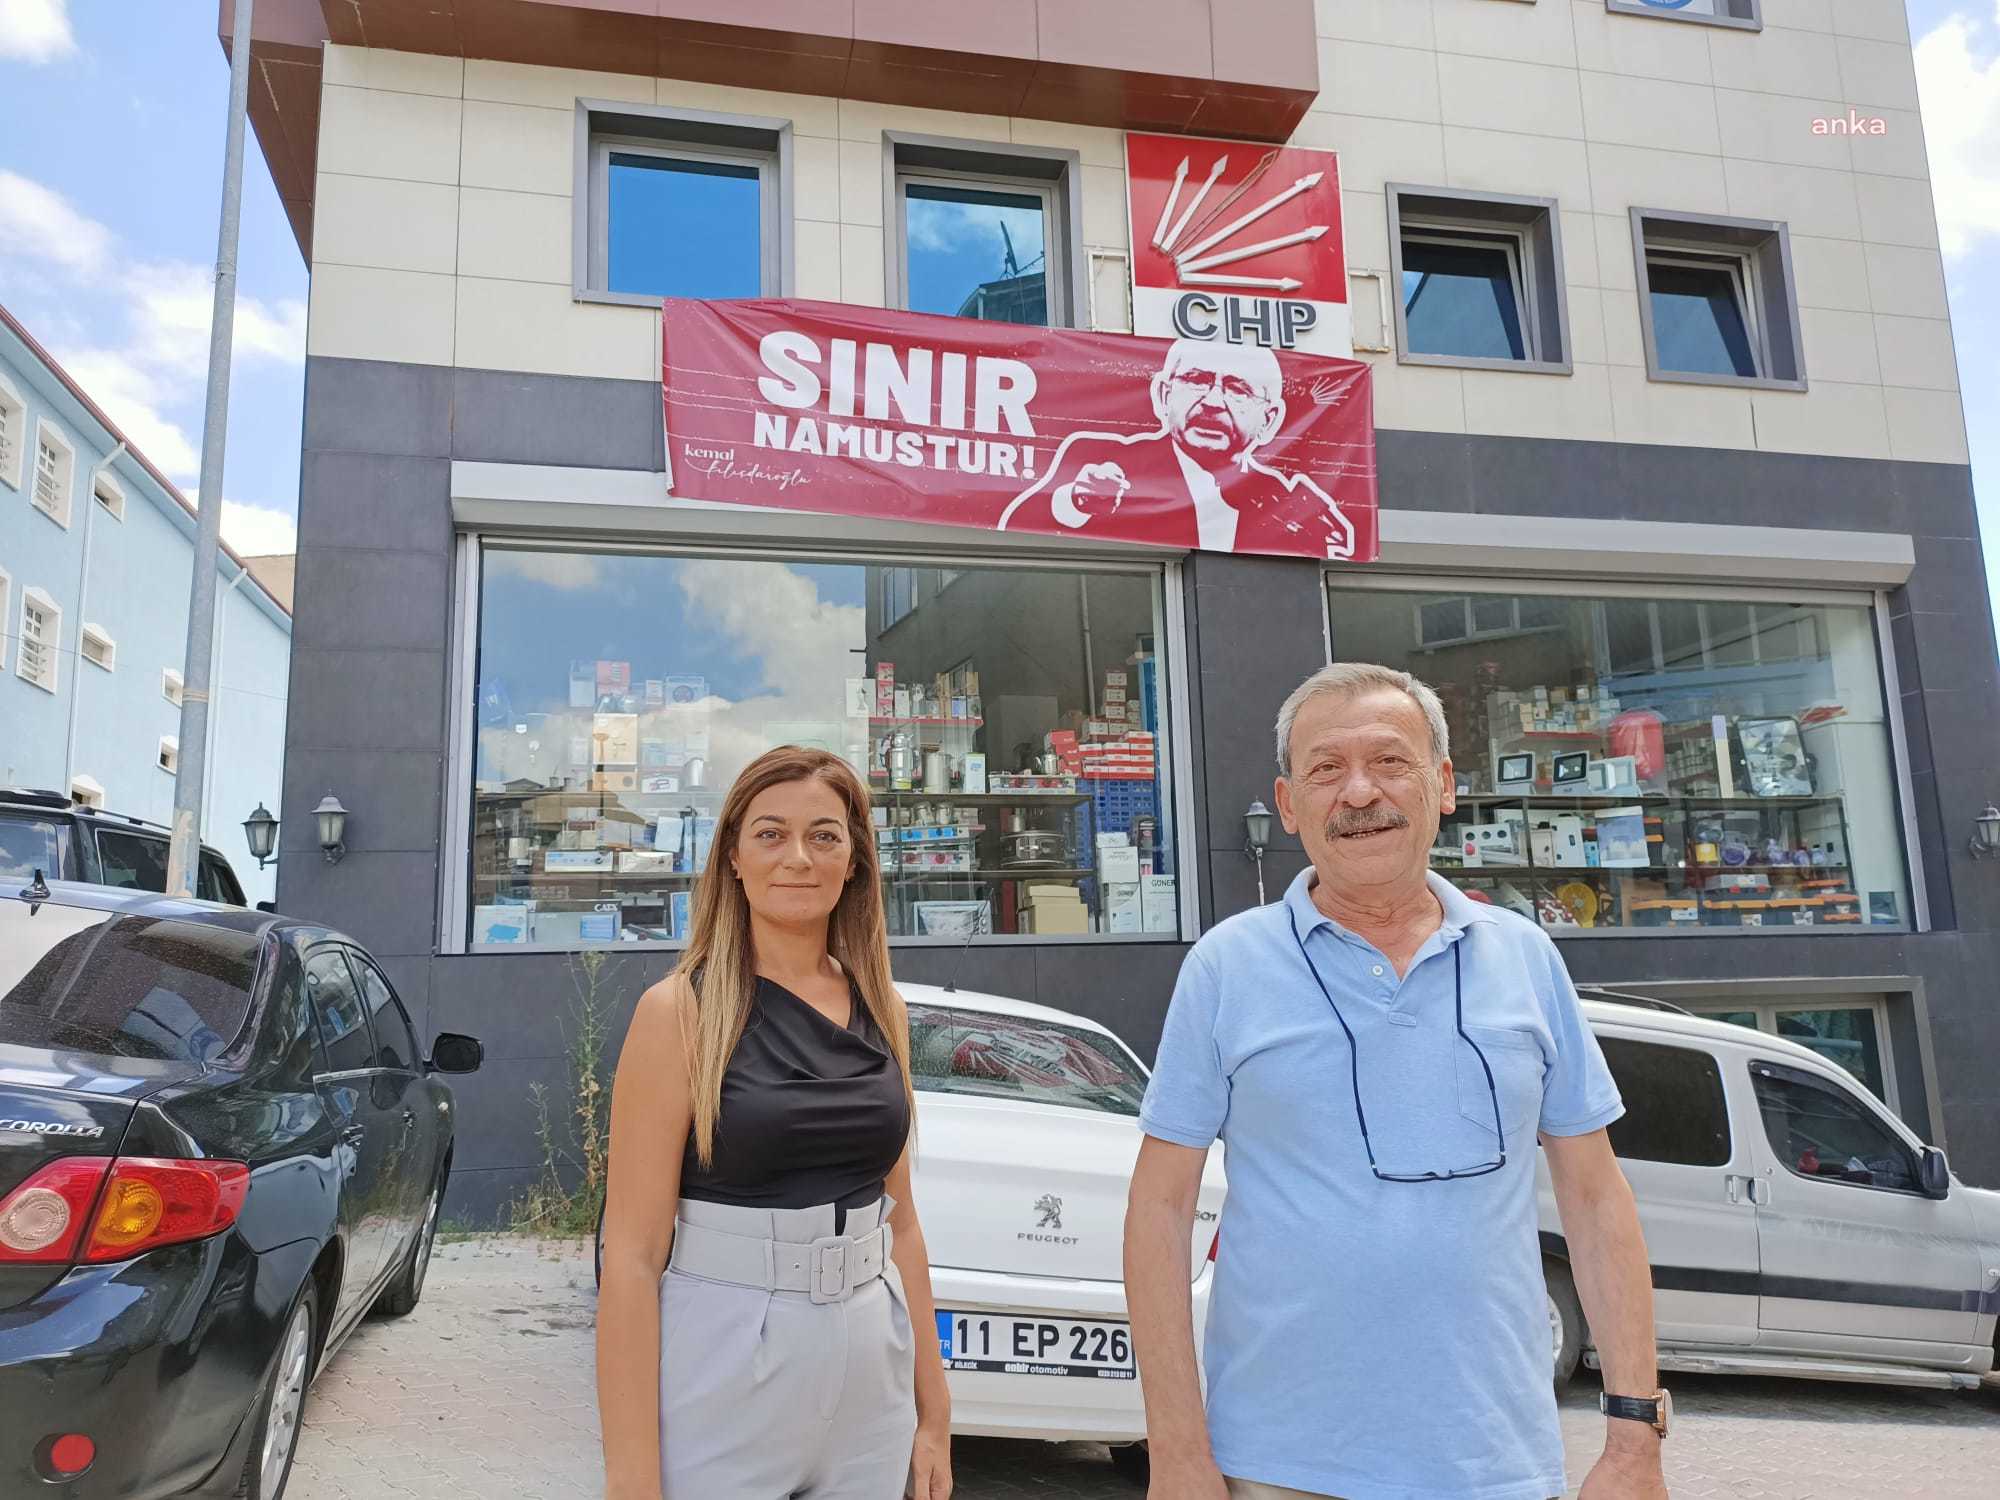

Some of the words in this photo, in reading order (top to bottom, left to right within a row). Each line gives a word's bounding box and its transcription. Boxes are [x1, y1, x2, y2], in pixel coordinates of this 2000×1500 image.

[1173, 293, 1317, 348] CHP
[757, 330, 1038, 438] SINIR
[684, 443, 735, 461] kemal
[753, 410, 1037, 480] NAMUSTUR!
[1016, 1232, 1079, 1245] PEUGEOT
[957, 1318, 990, 1355] 11
[1012, 1322, 1060, 1358] EP
[1069, 1326, 1129, 1363] 226
[1030, 1364, 1069, 1376] otomotiv
